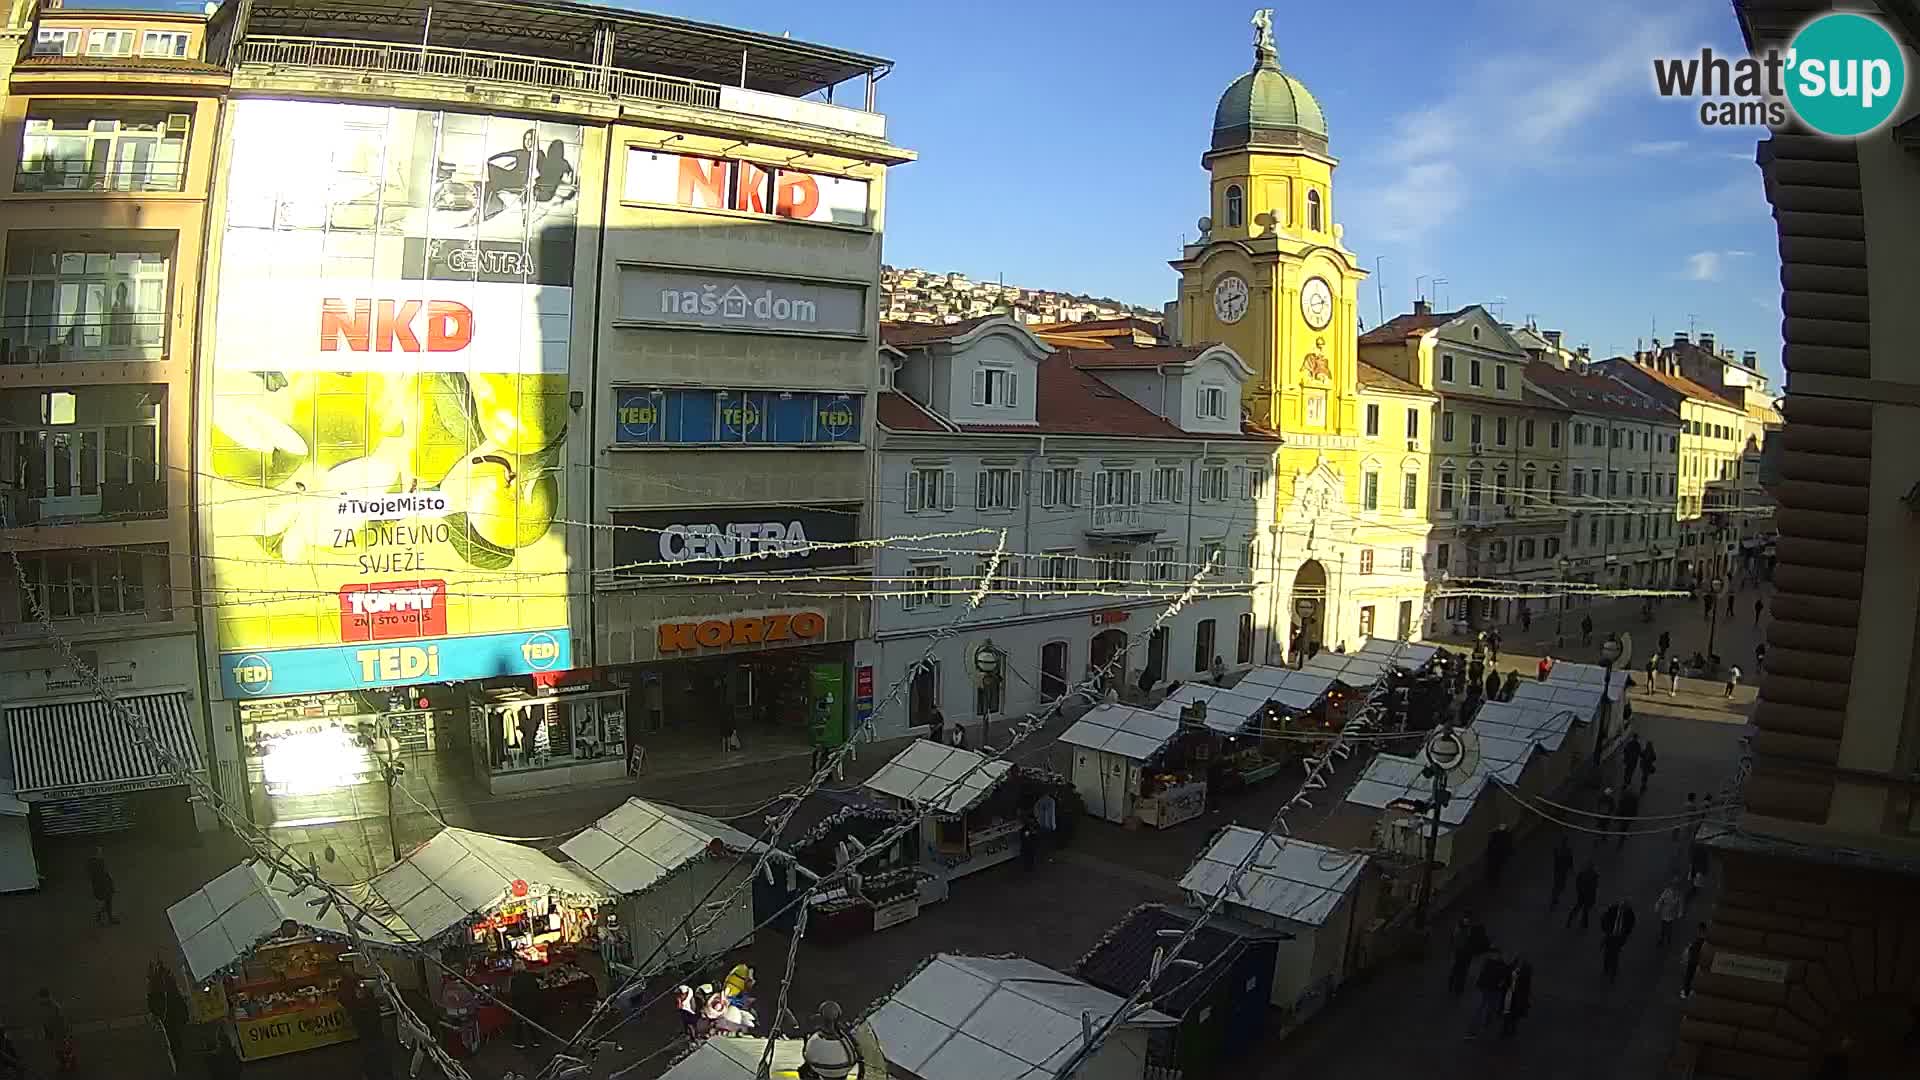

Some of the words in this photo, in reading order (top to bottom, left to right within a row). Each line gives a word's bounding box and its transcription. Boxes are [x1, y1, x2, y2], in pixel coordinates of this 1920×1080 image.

[679, 157, 820, 218] NKD
[447, 249, 534, 275] CENTRA
[661, 284, 717, 317] naš
[754, 291, 817, 322] dom
[320, 297, 474, 353] NKD
[618, 407, 657, 425] TEDi
[722, 408, 760, 425] TEDi
[819, 410, 853, 426] TEDi
[338, 497, 446, 516] #TvojeMisto
[334, 528, 357, 548] ZA
[367, 523, 451, 547] DNEVNO
[658, 521, 809, 562] CENTRA
[359, 547, 425, 575] SVJEŽE
[347, 586, 440, 614] TOMMY
[658, 611, 826, 654] KORZO
[356, 646, 440, 682] TEDi
[520, 641, 560, 662] TEDi
[232, 666, 274, 684] TEDi
